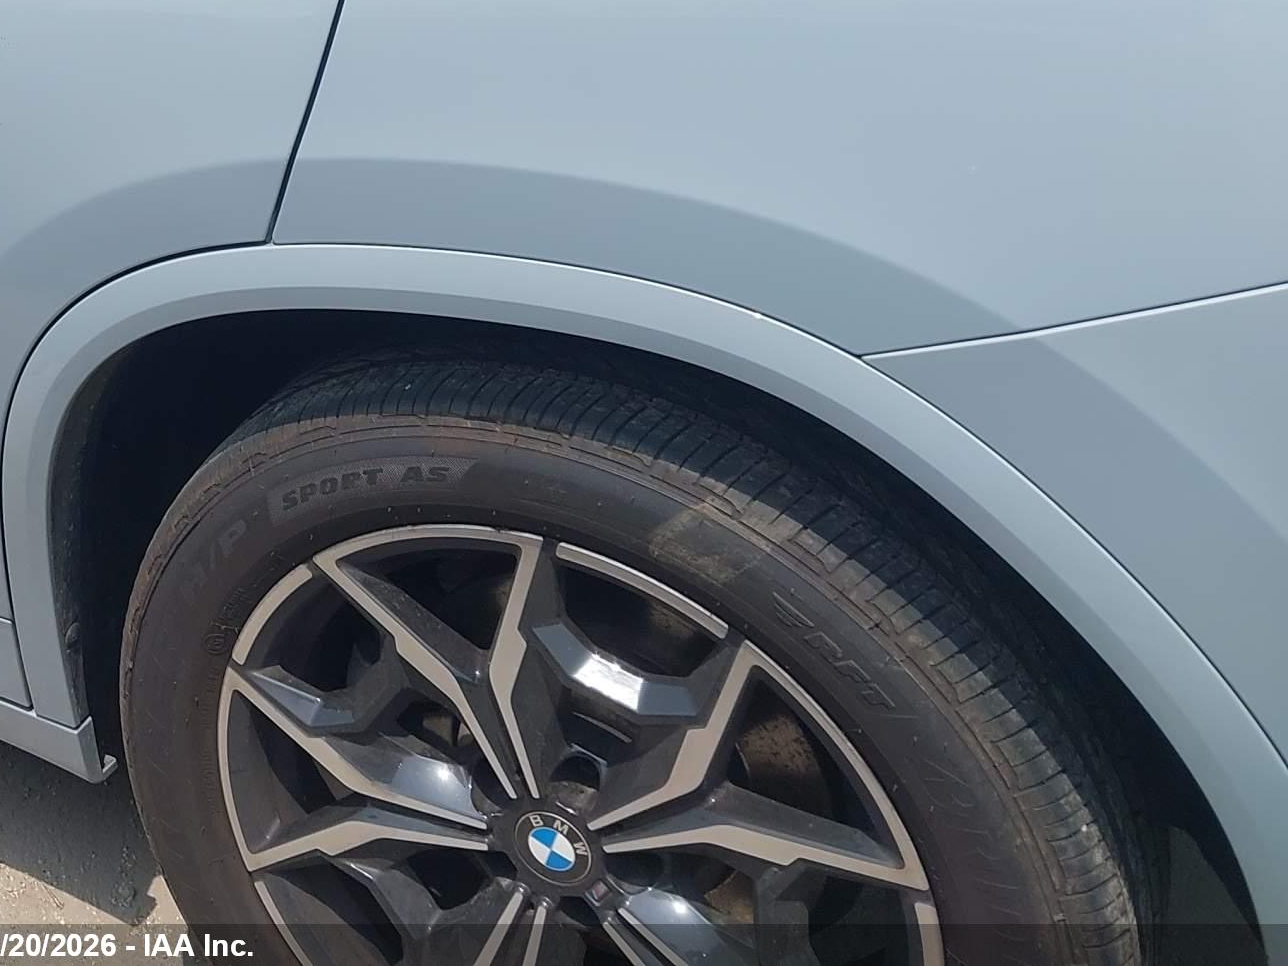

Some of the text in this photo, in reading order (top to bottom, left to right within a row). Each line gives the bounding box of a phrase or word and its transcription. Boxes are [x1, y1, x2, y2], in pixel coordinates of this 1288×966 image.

[281, 467, 383, 511] SPORT
[401, 466, 450, 483] AS
[528, 814, 588, 876] BMW
